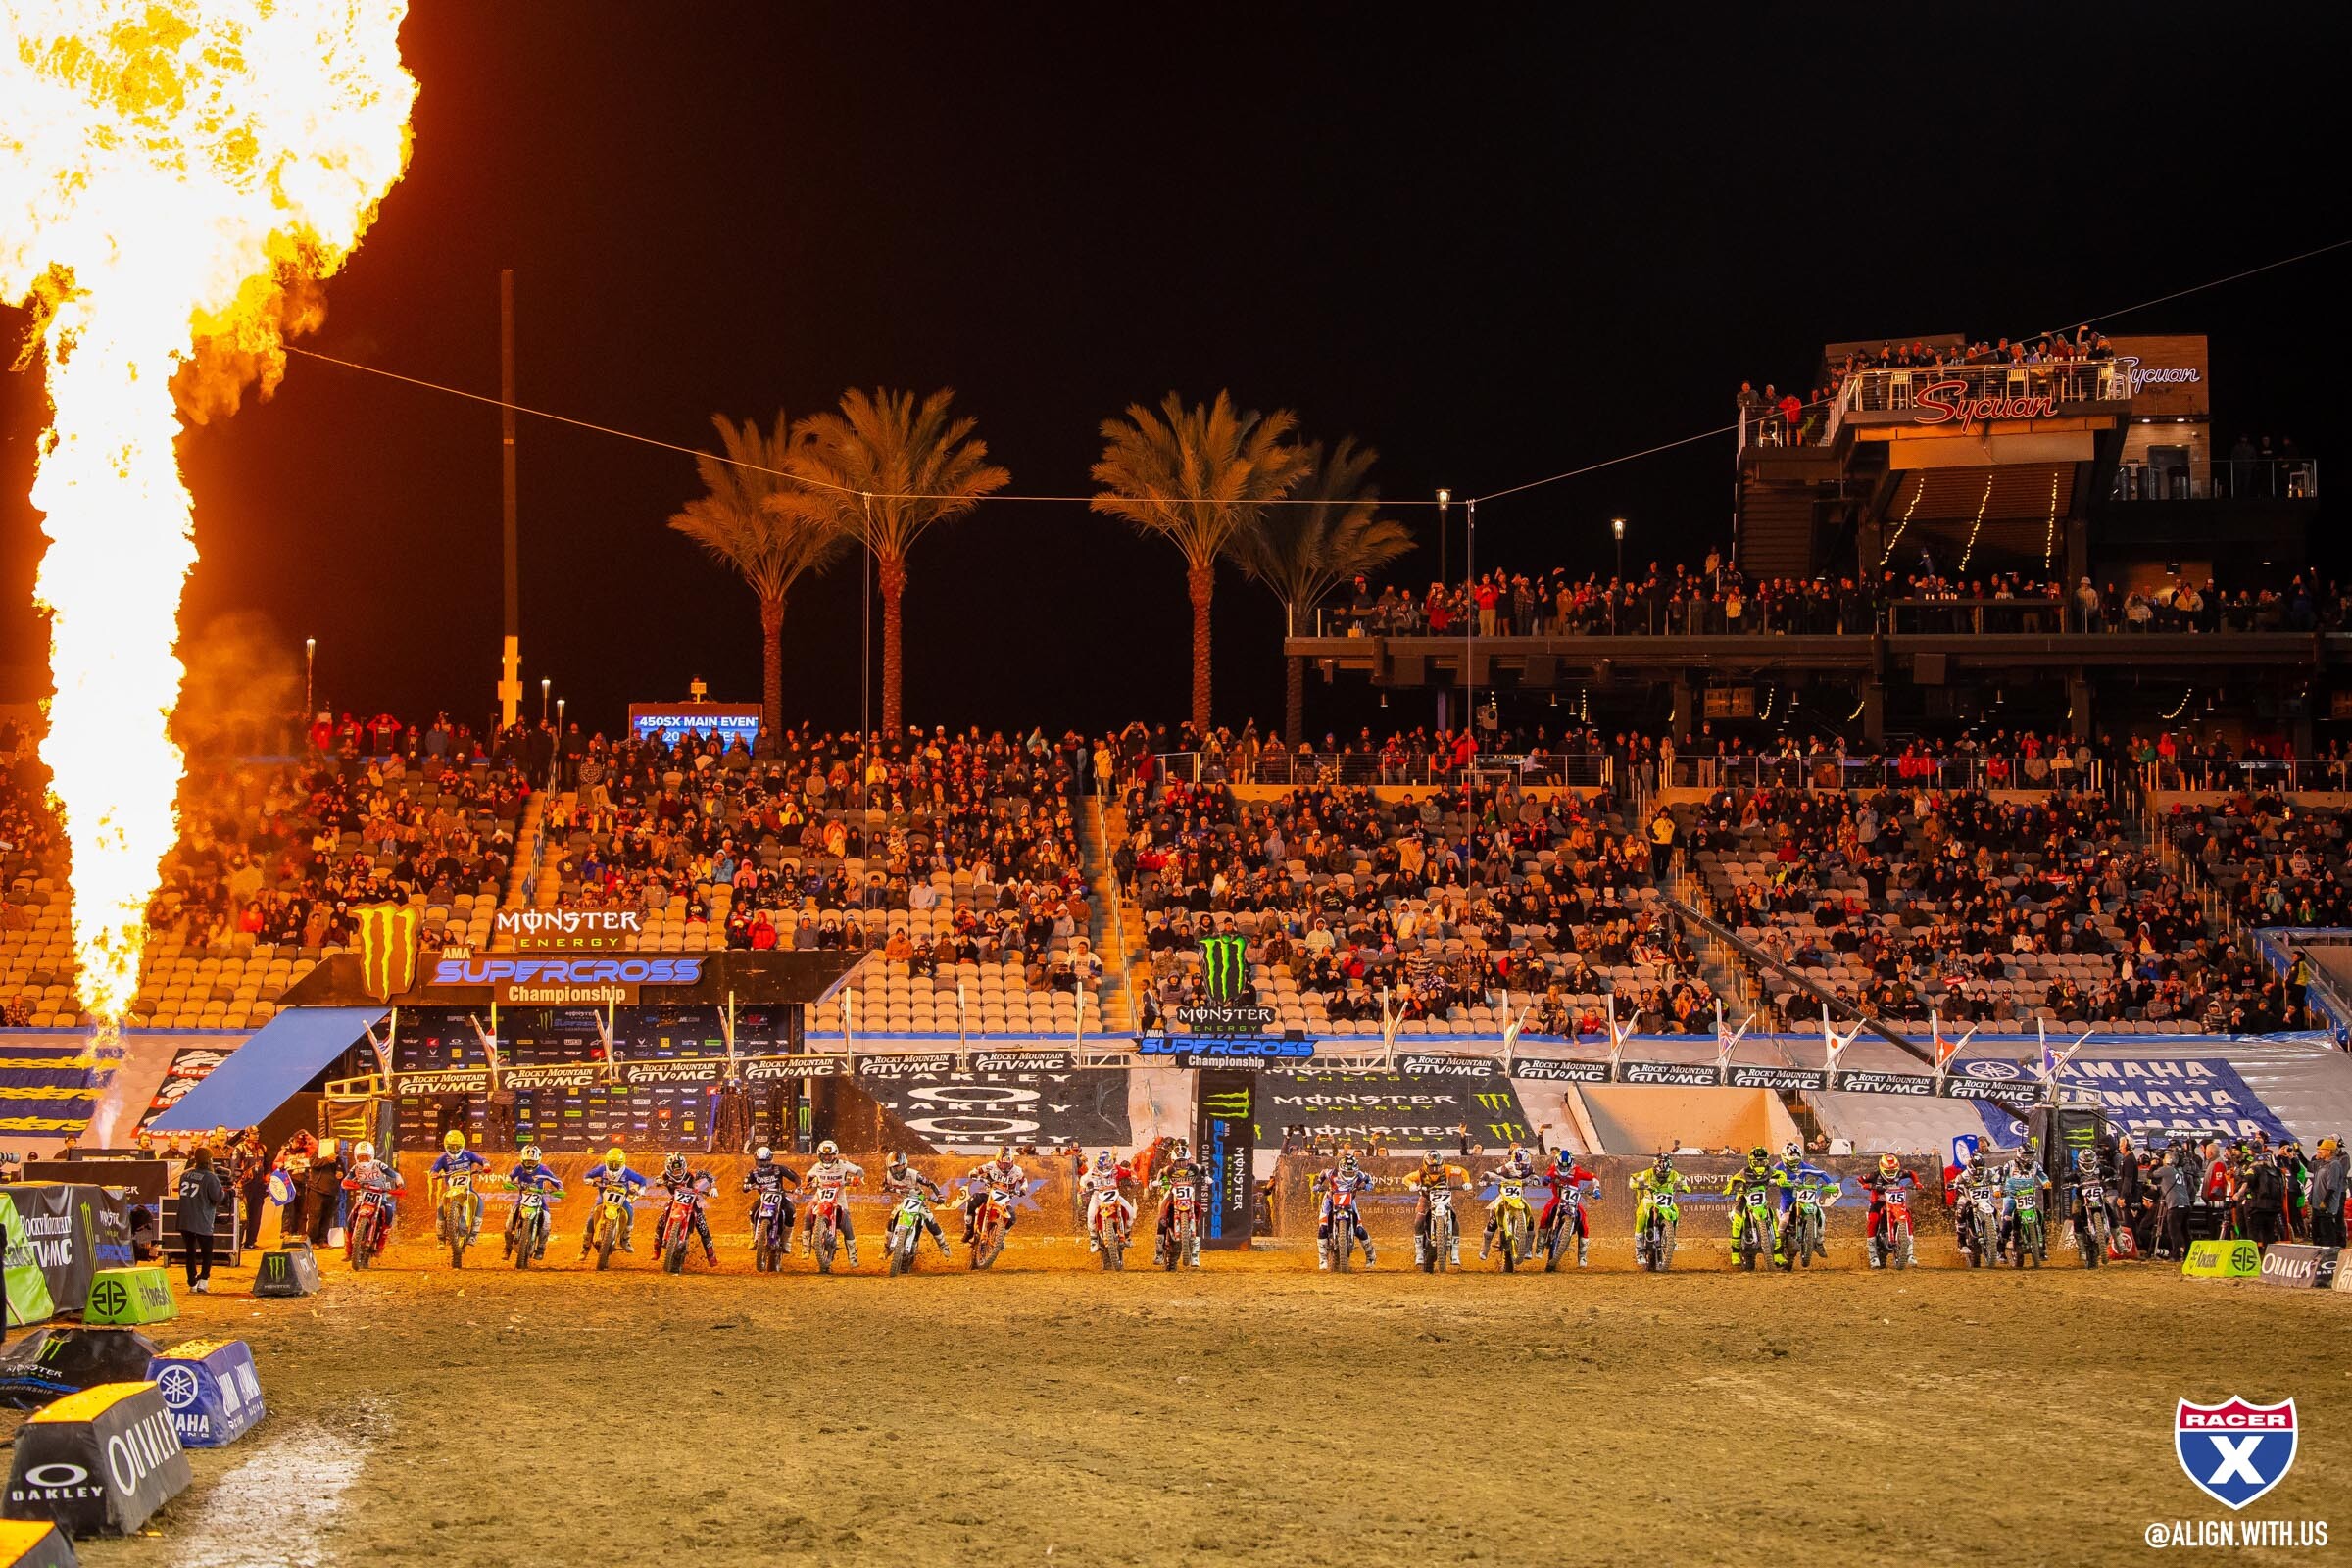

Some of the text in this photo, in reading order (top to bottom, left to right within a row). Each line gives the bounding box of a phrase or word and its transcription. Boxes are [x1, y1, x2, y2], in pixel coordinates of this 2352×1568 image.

[1914, 381, 2057, 433] Sycuan
[640, 717, 759, 727] 450SX MAIN EVEN
[665, 732, 680, 741] 20
[497, 909, 641, 934] MONSTER
[520, 938, 619, 947] ENERGY
[442, 948, 471, 959] AMA
[434, 960, 705, 982] SUPERCROSS
[508, 986, 626, 1004] Championship
[1179, 1007, 1272, 1022] MONSTER
[1140, 1039, 1316, 1056] SUPERCROSS
[1188, 1055, 1265, 1069] Championship
[1447, 1058, 1492, 1067] MOUNTAIN
[1532, 1060, 1605, 1071] ROCKY MOUNTAIN
[1642, 1064, 1714, 1075] ROCKY MOUNTAIN
[1748, 1068, 1820, 1080] ROCKY MOUNTAIN
[1858, 1073, 1930, 1084] ROCKY MOUNTAIN
[1963, 1080, 2035, 1092] ROCKY MOUNTAIN
[1272, 1093, 1461, 1106] MONSTER
[452, 1177, 467, 1186] 12
[992, 1173, 1013, 1183] THOR
[1201, 1144, 1210, 1213] CHAMNSHIP
[1211, 1119, 1224, 1239] SUPERCROSS
[1233, 1147, 1244, 1211] MONSTER
[180, 1181, 199, 1197] 27
[820, 1190, 835, 1199] 15
[1176, 1188, 1191, 1198] 51
[1506, 1188, 1520, 1196] 94
[1972, 1190, 1989, 1199] 28
[2086, 1188, 2100, 1197] 46
[364, 1192, 381, 1203] 60
[524, 1193, 539, 1203] 73
[607, 1193, 621, 1203] 11
[677, 1193, 693, 1203] 23
[764, 1194, 780, 1204] 40
[994, 1191, 1007, 1202] 7
[1103, 1191, 1116, 1202] 2
[1338, 1193, 1348, 1204] 1
[1564, 1192, 1578, 1201] 14
[1656, 1195, 1672, 1205] 21
[1751, 1193, 1763, 1205] 9
[1799, 1192, 1815, 1201] 47
[1889, 1193, 1904, 1203] 45
[2017, 1196, 2034, 1208] 519
[903, 1200, 920, 1210] 17
[6, 1364, 62, 1377] MONSTER
[171, 1413, 209, 1432] AHA
[126, 1407, 181, 1479] OAKLEY
[12, 1486, 104, 1501] OAKLEY
